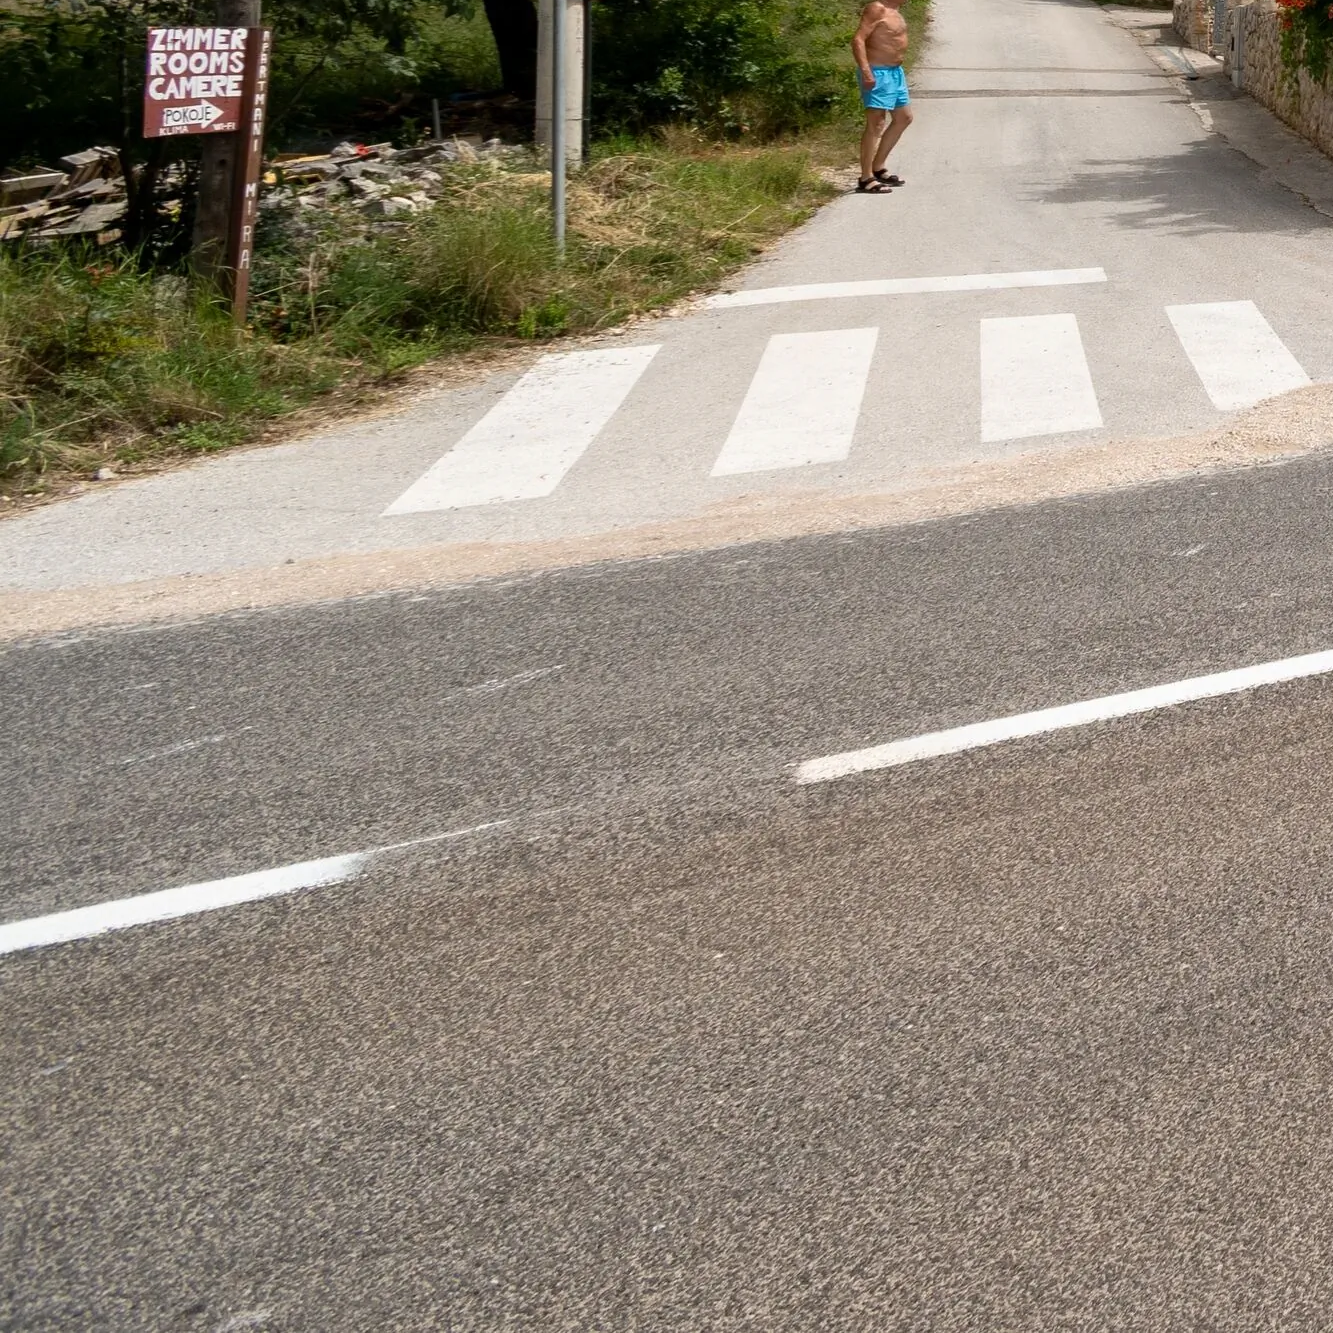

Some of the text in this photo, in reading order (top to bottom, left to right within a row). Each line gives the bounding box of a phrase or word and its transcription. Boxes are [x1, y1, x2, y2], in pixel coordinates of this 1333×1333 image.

[151, 28, 248, 51] ZIMMER
[151, 51, 245, 76] ROOMS
[150, 75, 244, 100] CAMERE
[165, 106, 212, 124] POKOJE
[159, 125, 189, 136] KLIMA
[240, 30, 270, 270] APARTMANI MIRA
